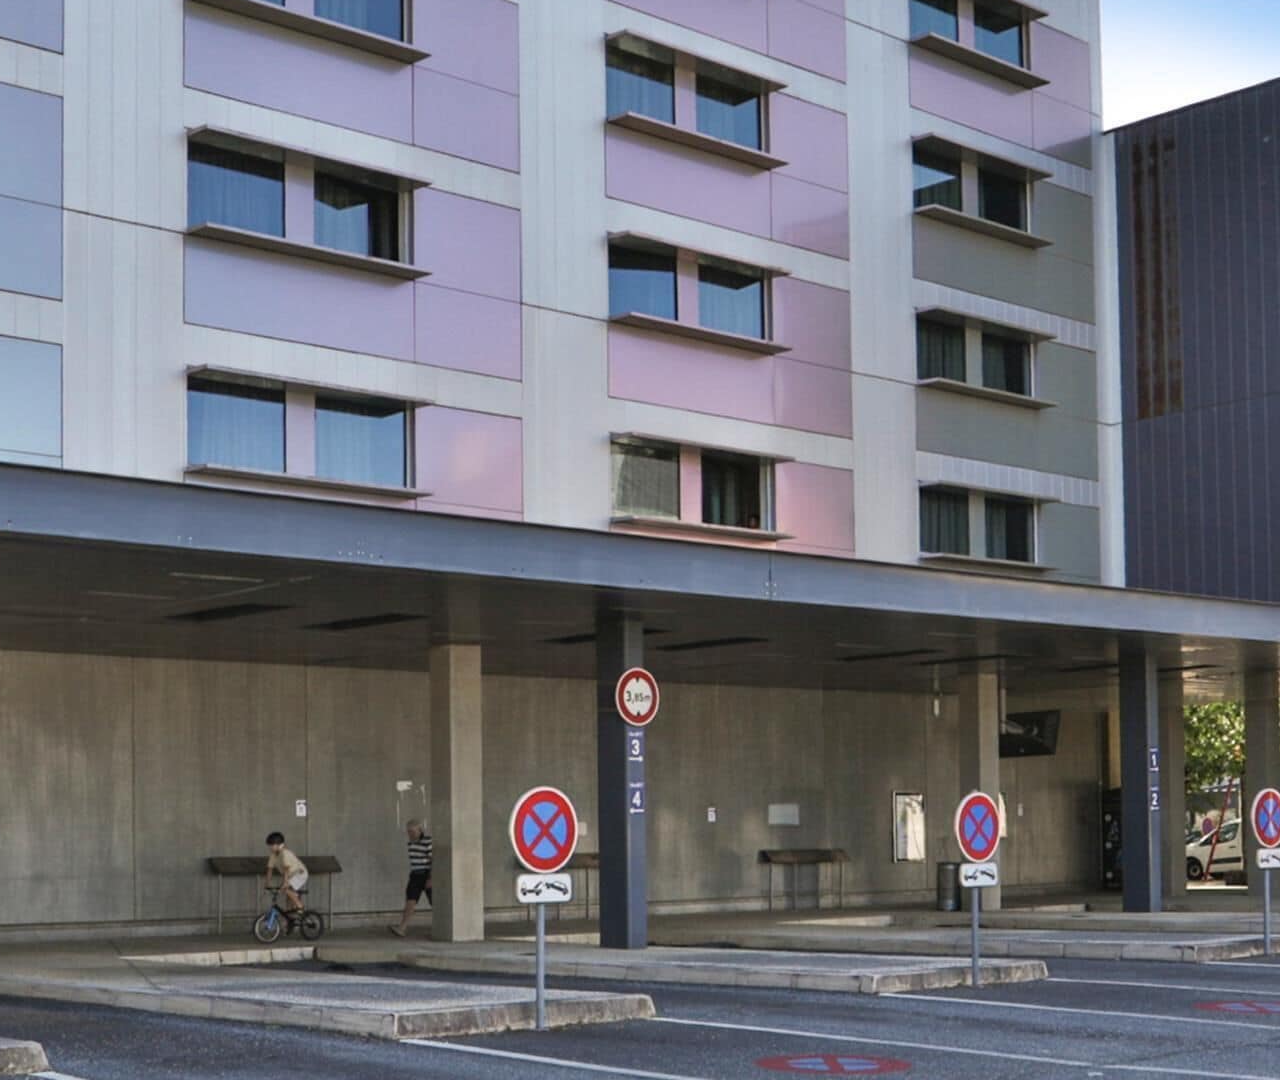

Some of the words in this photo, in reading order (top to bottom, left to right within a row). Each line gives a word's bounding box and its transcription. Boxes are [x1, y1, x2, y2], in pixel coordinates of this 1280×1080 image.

[631, 739, 640, 755] 3
[631, 791, 641, 807] 4
[1151, 793, 1158, 805] 2
